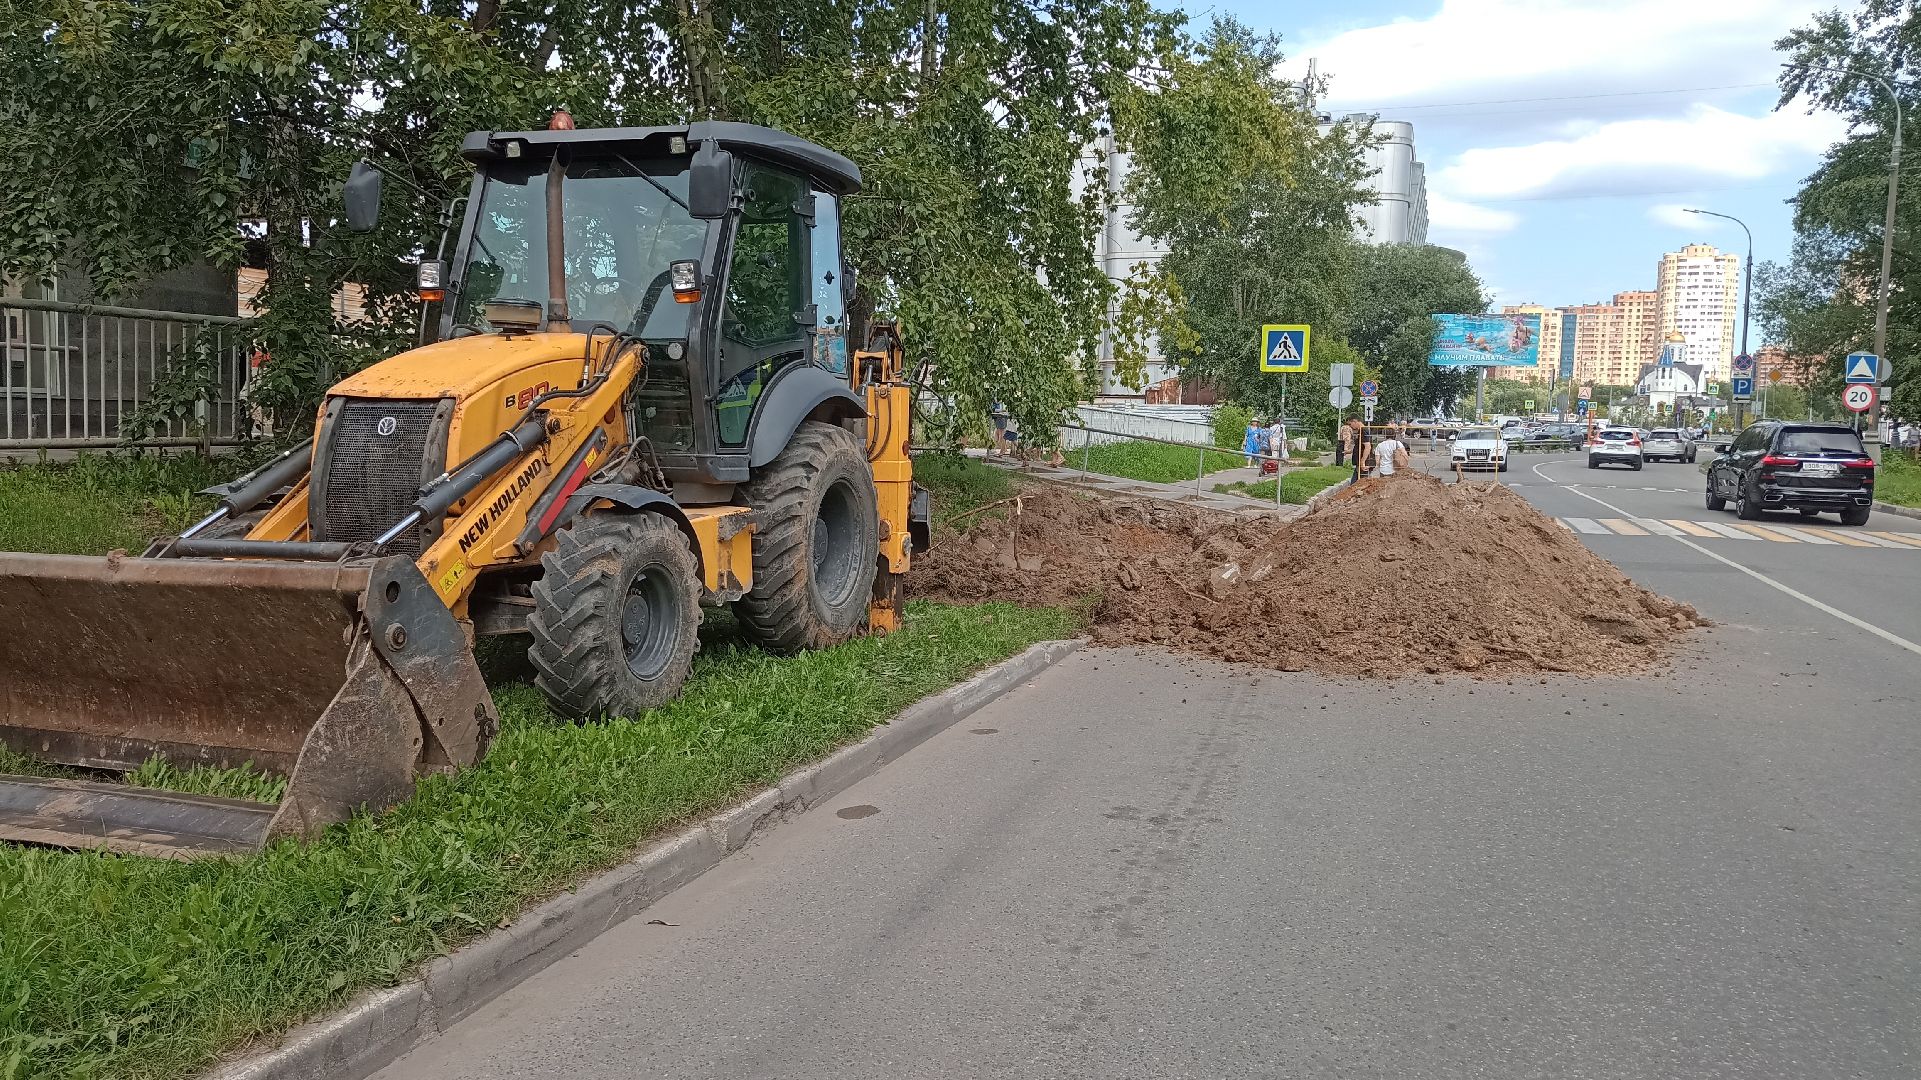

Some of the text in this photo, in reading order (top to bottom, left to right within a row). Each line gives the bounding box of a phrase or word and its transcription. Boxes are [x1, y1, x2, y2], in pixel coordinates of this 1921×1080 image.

[1738, 380, 1749, 393] P
[1849, 391, 1868, 403] 20
[459, 457, 542, 554] NEW HOLLAND
